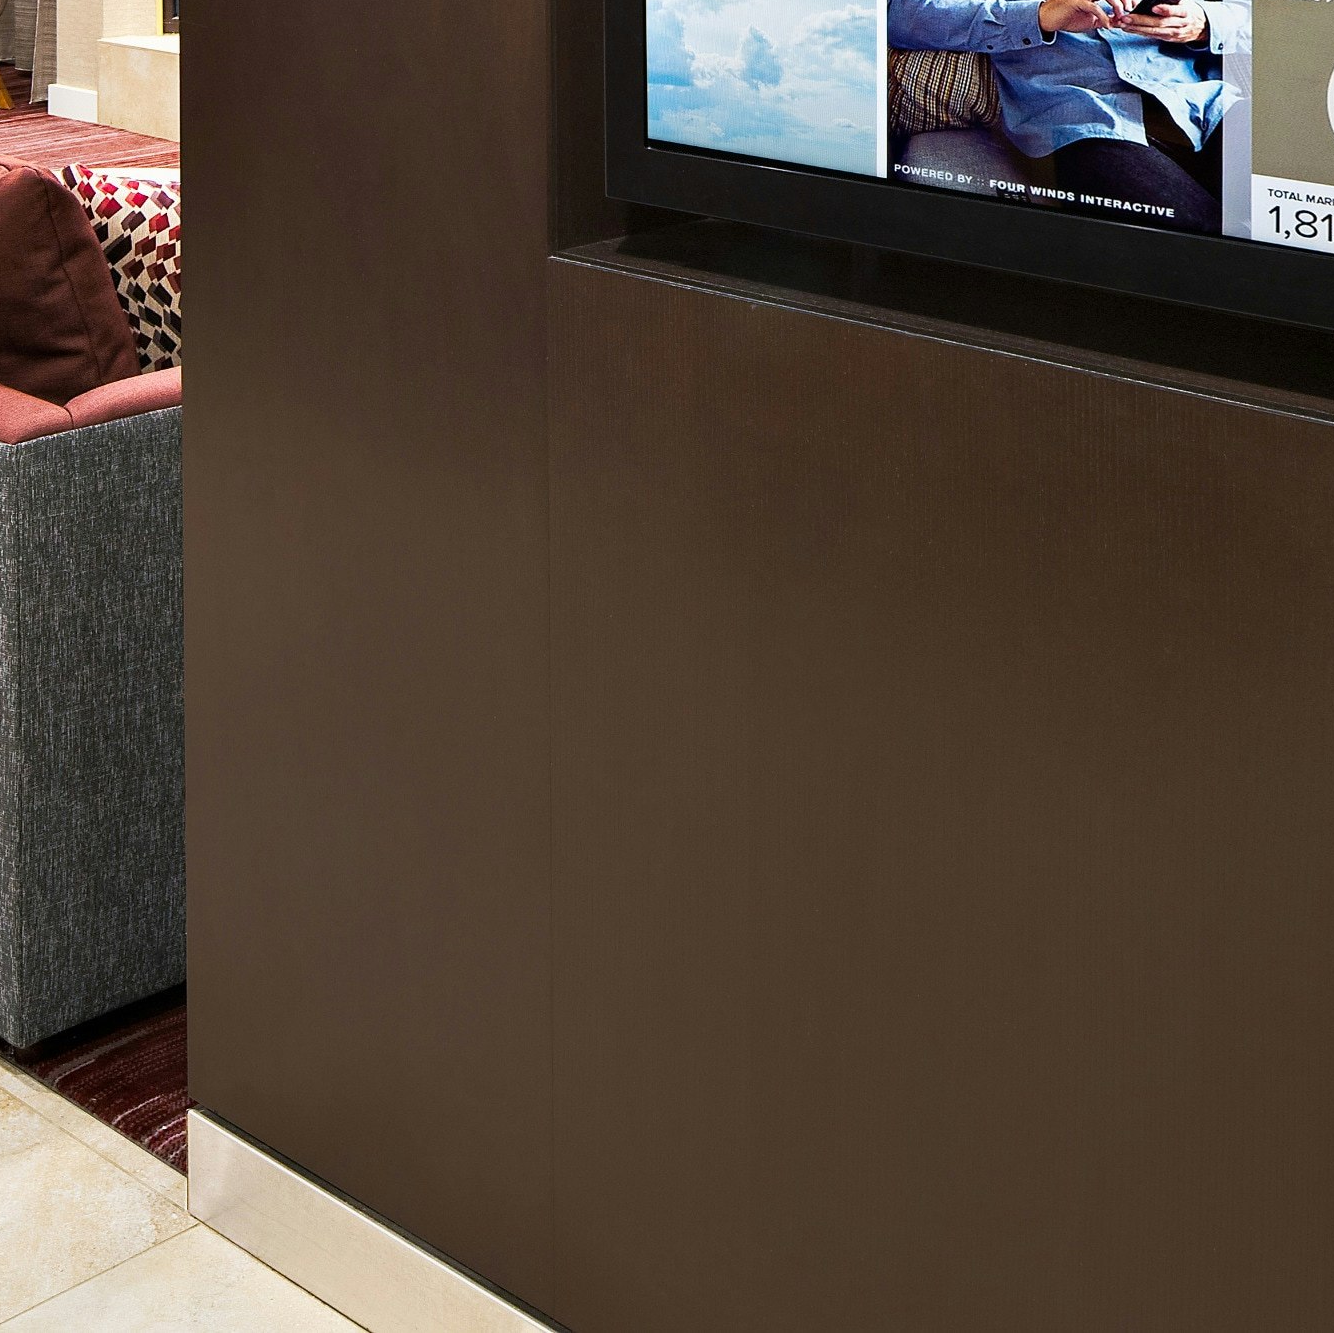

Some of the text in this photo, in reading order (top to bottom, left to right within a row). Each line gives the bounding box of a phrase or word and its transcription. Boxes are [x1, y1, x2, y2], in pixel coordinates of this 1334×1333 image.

[894, 163, 953, 181] POWERED
[957, 174, 972, 184] BY
[989, 179, 1025, 193] FOUR
[1030, 186, 1075, 201] WINDS
[1080, 194, 1174, 218] INTERACTIVE
[1267, 188, 1302, 202] TOTAL
